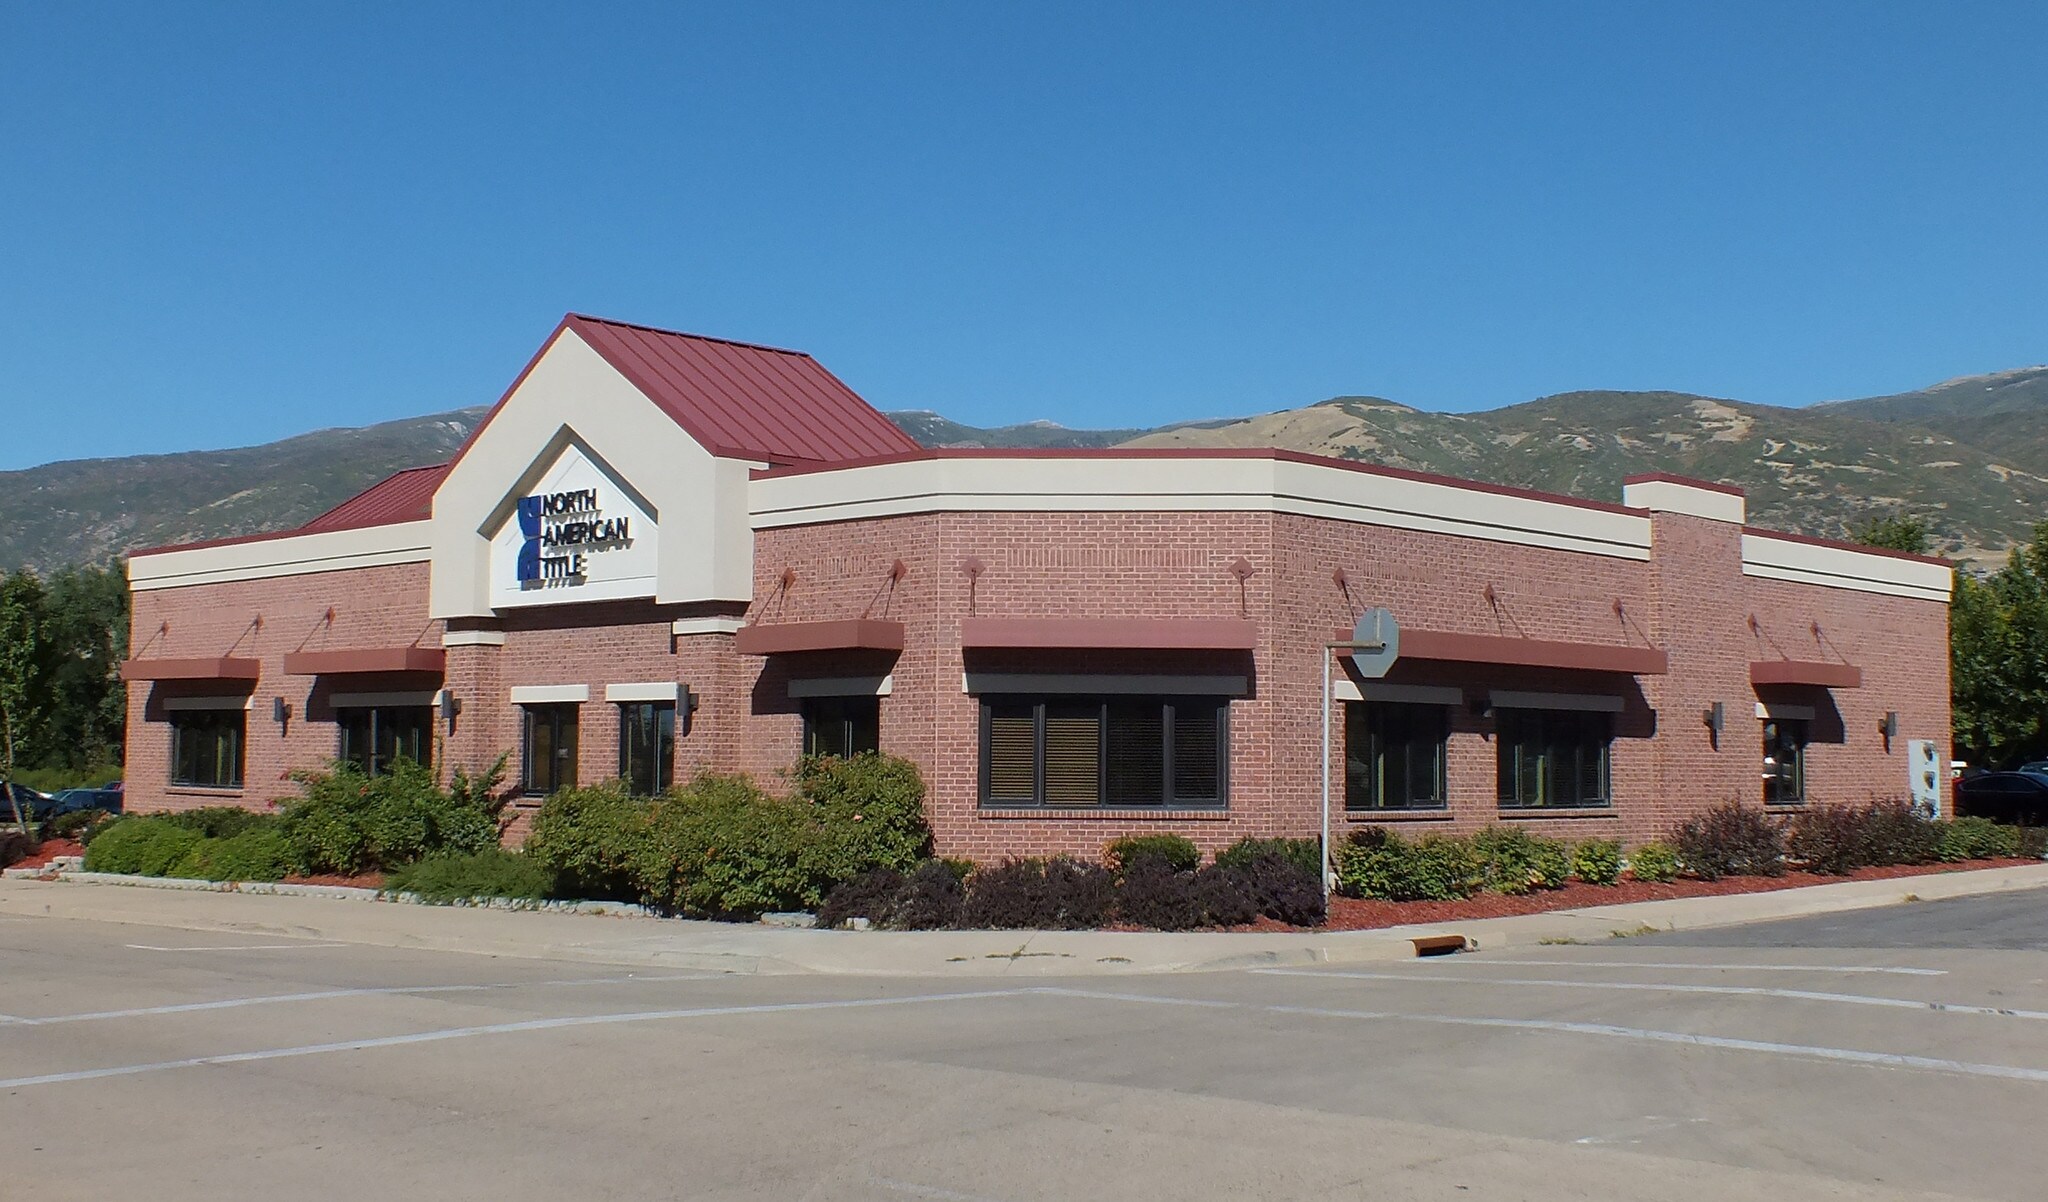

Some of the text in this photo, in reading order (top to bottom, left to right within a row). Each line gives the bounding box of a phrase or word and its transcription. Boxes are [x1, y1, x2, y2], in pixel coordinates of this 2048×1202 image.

[542, 488, 597, 516] NORTH
[542, 517, 629, 547] AMERICAN
[542, 554, 582, 578] TITLE
